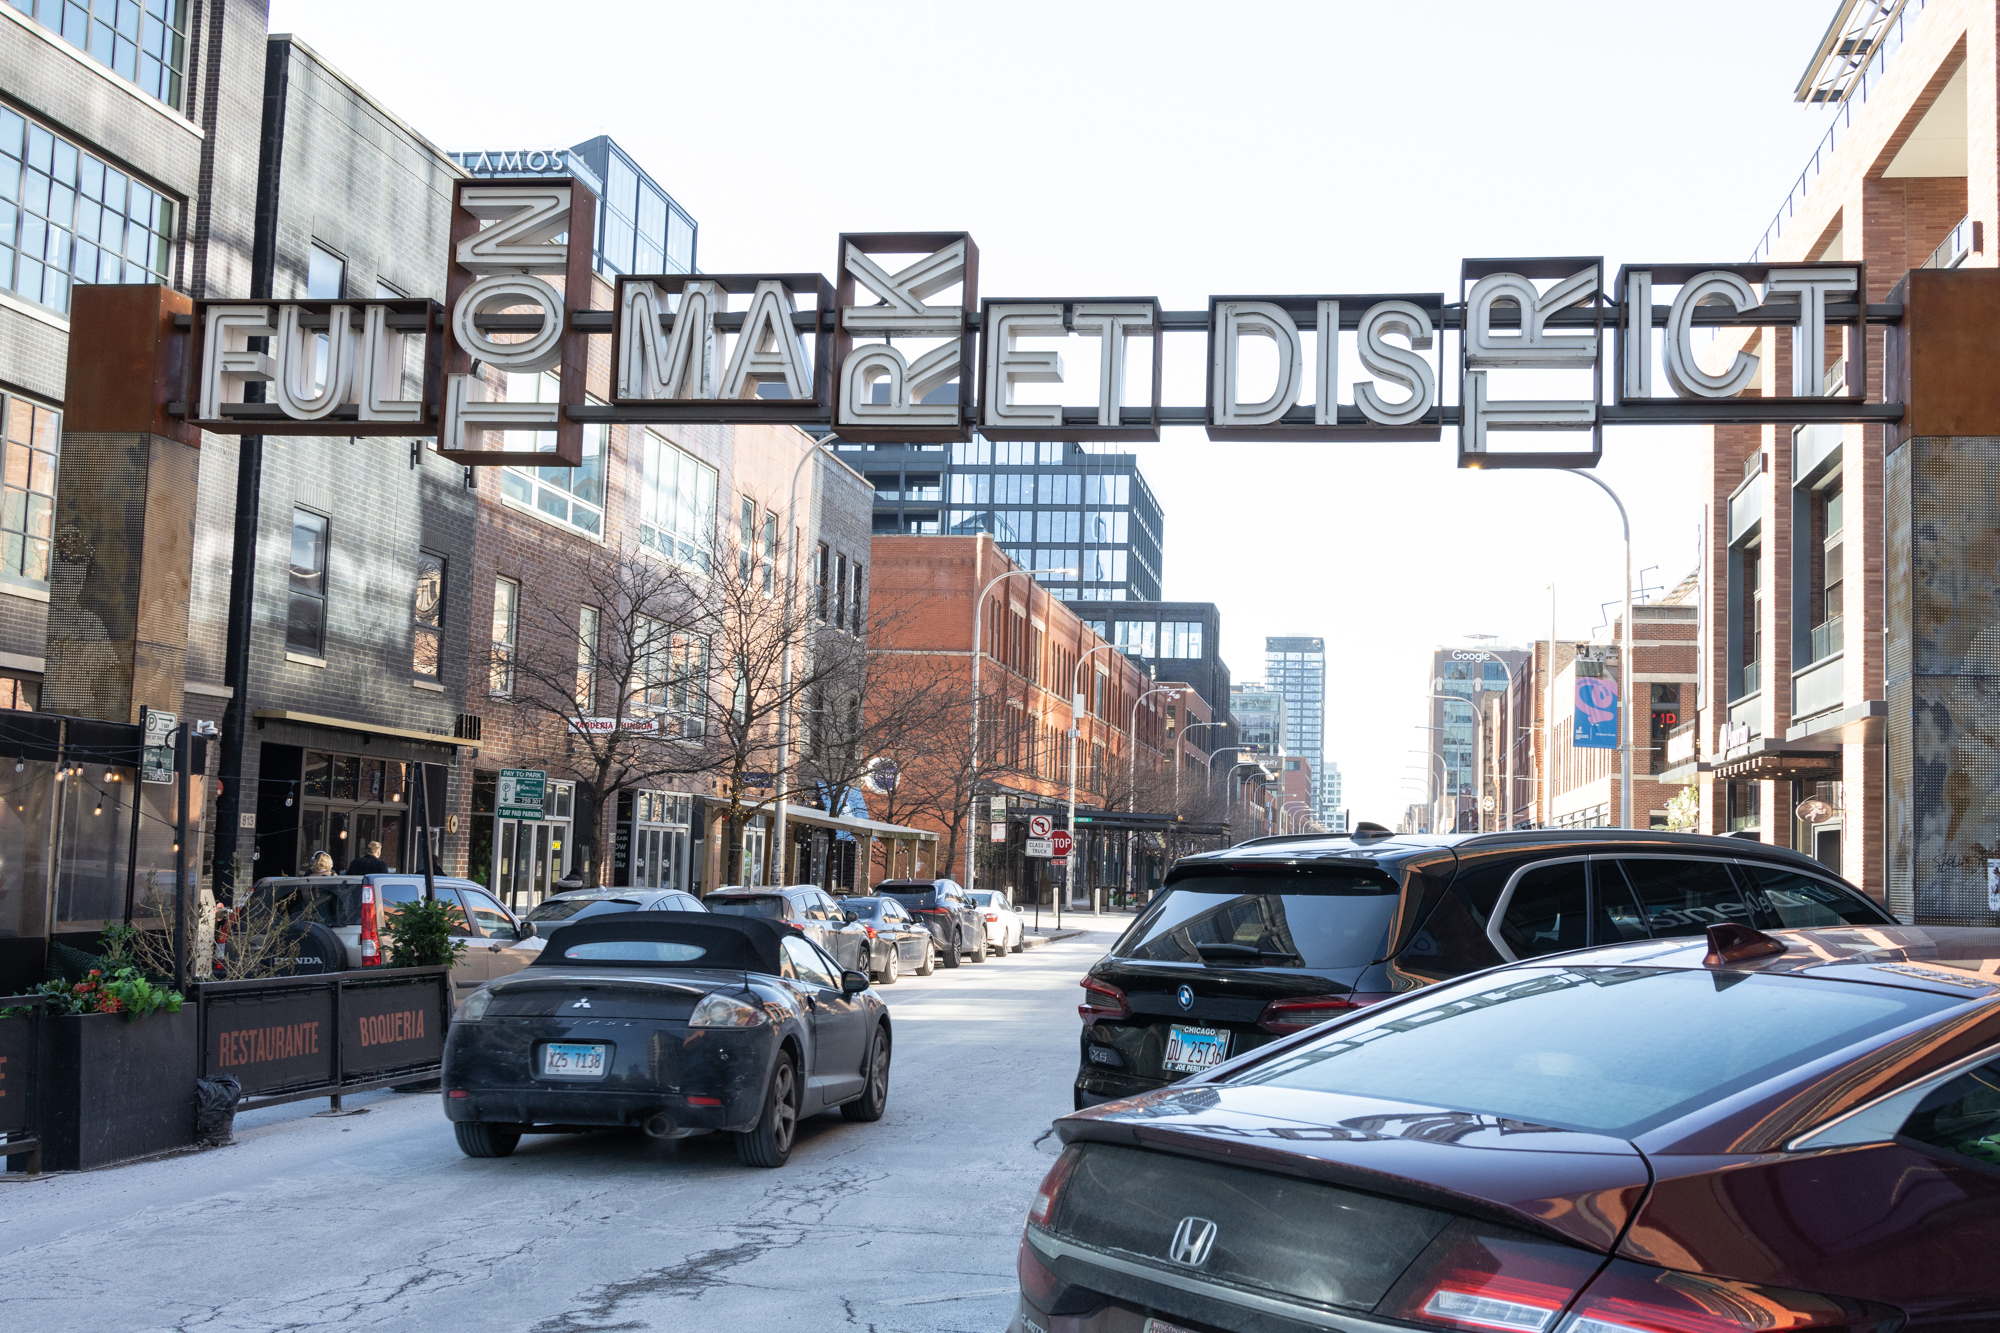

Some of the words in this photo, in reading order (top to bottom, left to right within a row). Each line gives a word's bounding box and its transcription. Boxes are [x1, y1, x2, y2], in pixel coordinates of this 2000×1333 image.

[199, 186, 571, 451] FULTON
[617, 239, 1153, 427] MARKET
[1213, 264, 1858, 454] DISTRICT
[1452, 650, 1490, 663] Google
[621, 721, 653, 730] HINGON
[242, 815, 254, 826] 813
[359, 1009, 425, 1047] BOQUERIA
[1184, 1026, 1216, 1036] CHICAGO
[219, 1021, 319, 1067] RESTAURANTE
[1090, 1049, 1108, 1062] X5
[1167, 1039, 1184, 1060] DU
[1188, 1041, 1223, 1065] 25736
[548, 1052, 568, 1068] X25
[575, 1053, 601, 1068] 7138
[1175, 1063, 1186, 1071] JOE
